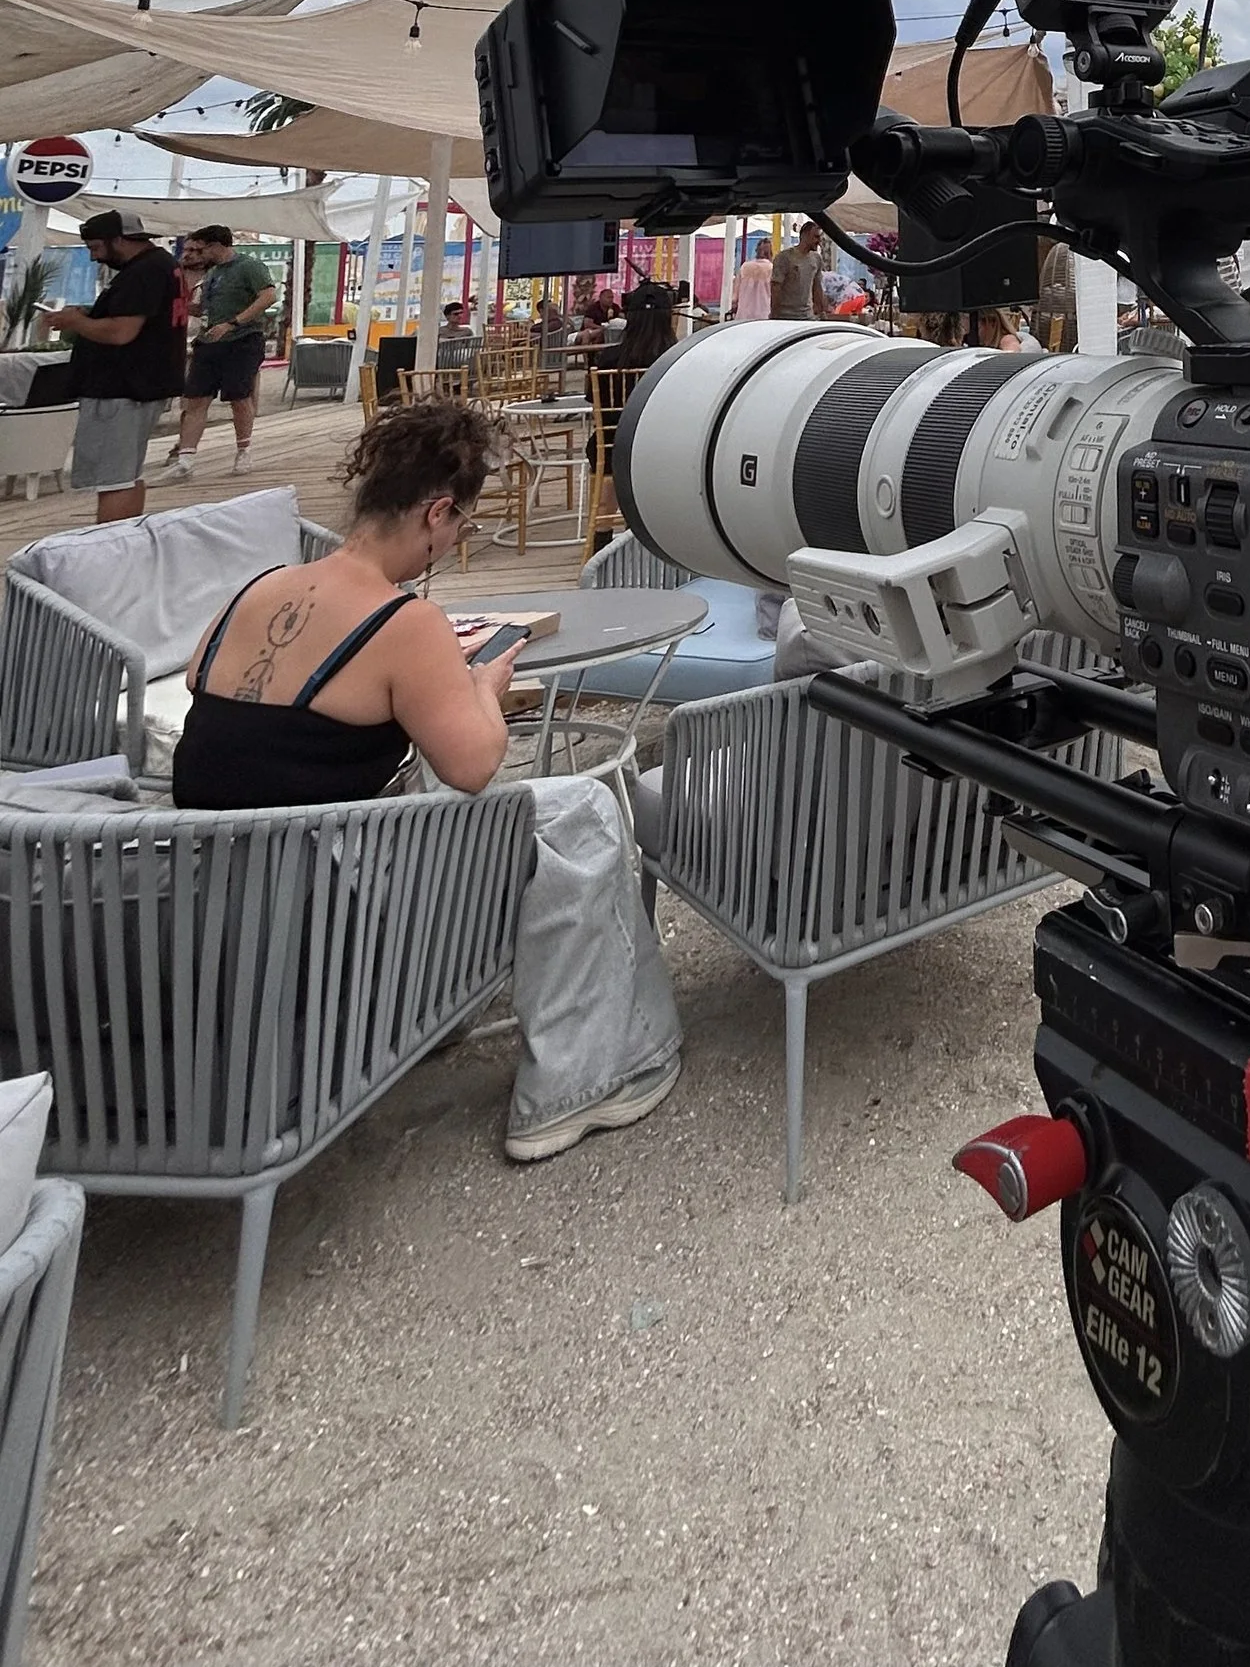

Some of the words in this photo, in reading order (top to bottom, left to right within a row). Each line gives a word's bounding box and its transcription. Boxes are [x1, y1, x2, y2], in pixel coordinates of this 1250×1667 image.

[17, 159, 89, 179] PEPSI
[1214, 404, 1238, 413] HOLD
[742, 457, 756, 484] G
[1132, 458, 1161, 468] PRESET
[1216, 570, 1232, 583] IRIS
[1166, 627, 1202, 646] THUMBNAIL
[1211, 638, 1229, 654] FULL
[1230, 643, 1250, 658] MENU
[1214, 670, 1238, 685] MENU
[1198, 703, 1233, 722] ISO/GAIN
[1107, 1228, 1149, 1285] CAM
[1107, 1264, 1156, 1329] GEAR
[1086, 1303, 1130, 1367] Elite
[1136, 1345, 1162, 1397] 12
